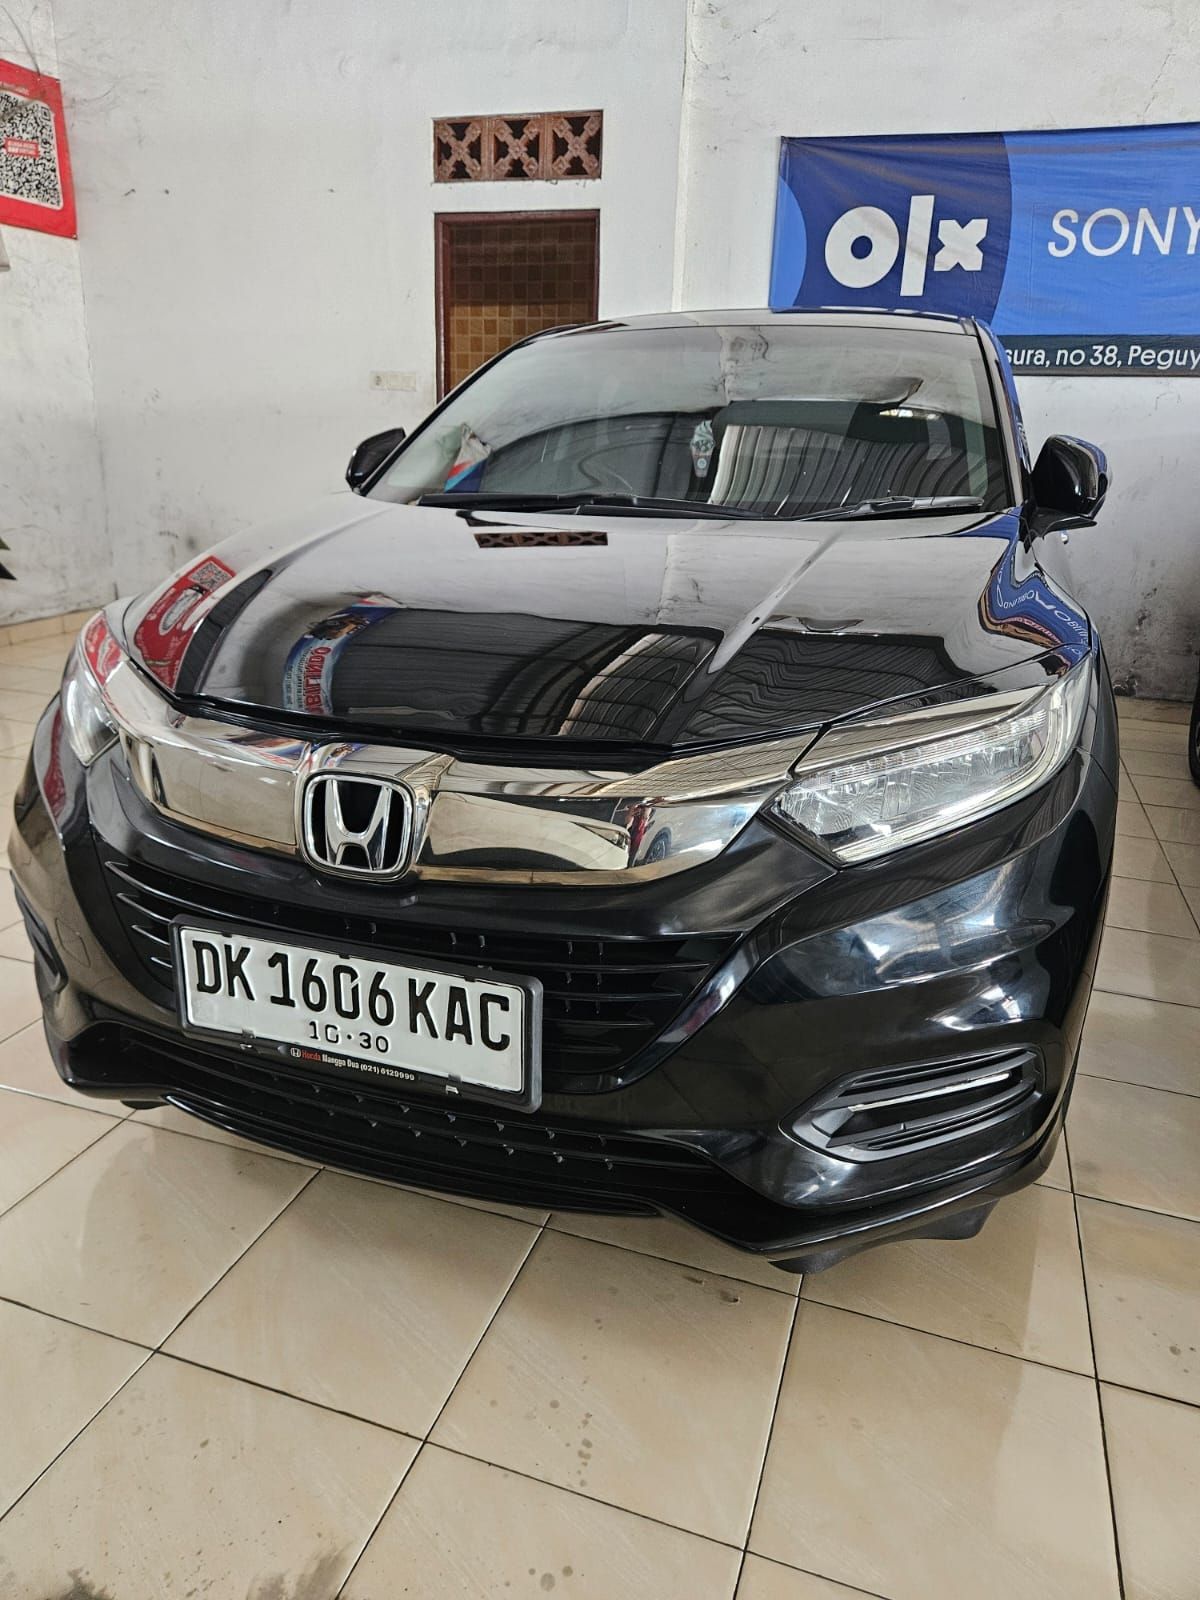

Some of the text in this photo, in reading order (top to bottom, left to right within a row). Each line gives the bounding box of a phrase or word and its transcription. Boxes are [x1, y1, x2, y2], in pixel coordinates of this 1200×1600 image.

[1056, 349, 1085, 366] no
[1090, 345, 1123, 368] 38,
[192, 940, 510, 1051] DK 1606 KAC
[322, 1054, 346, 1067] Mangga
[347, 1059, 360, 1069] Dua
[360, 1063, 380, 1075] (021)
